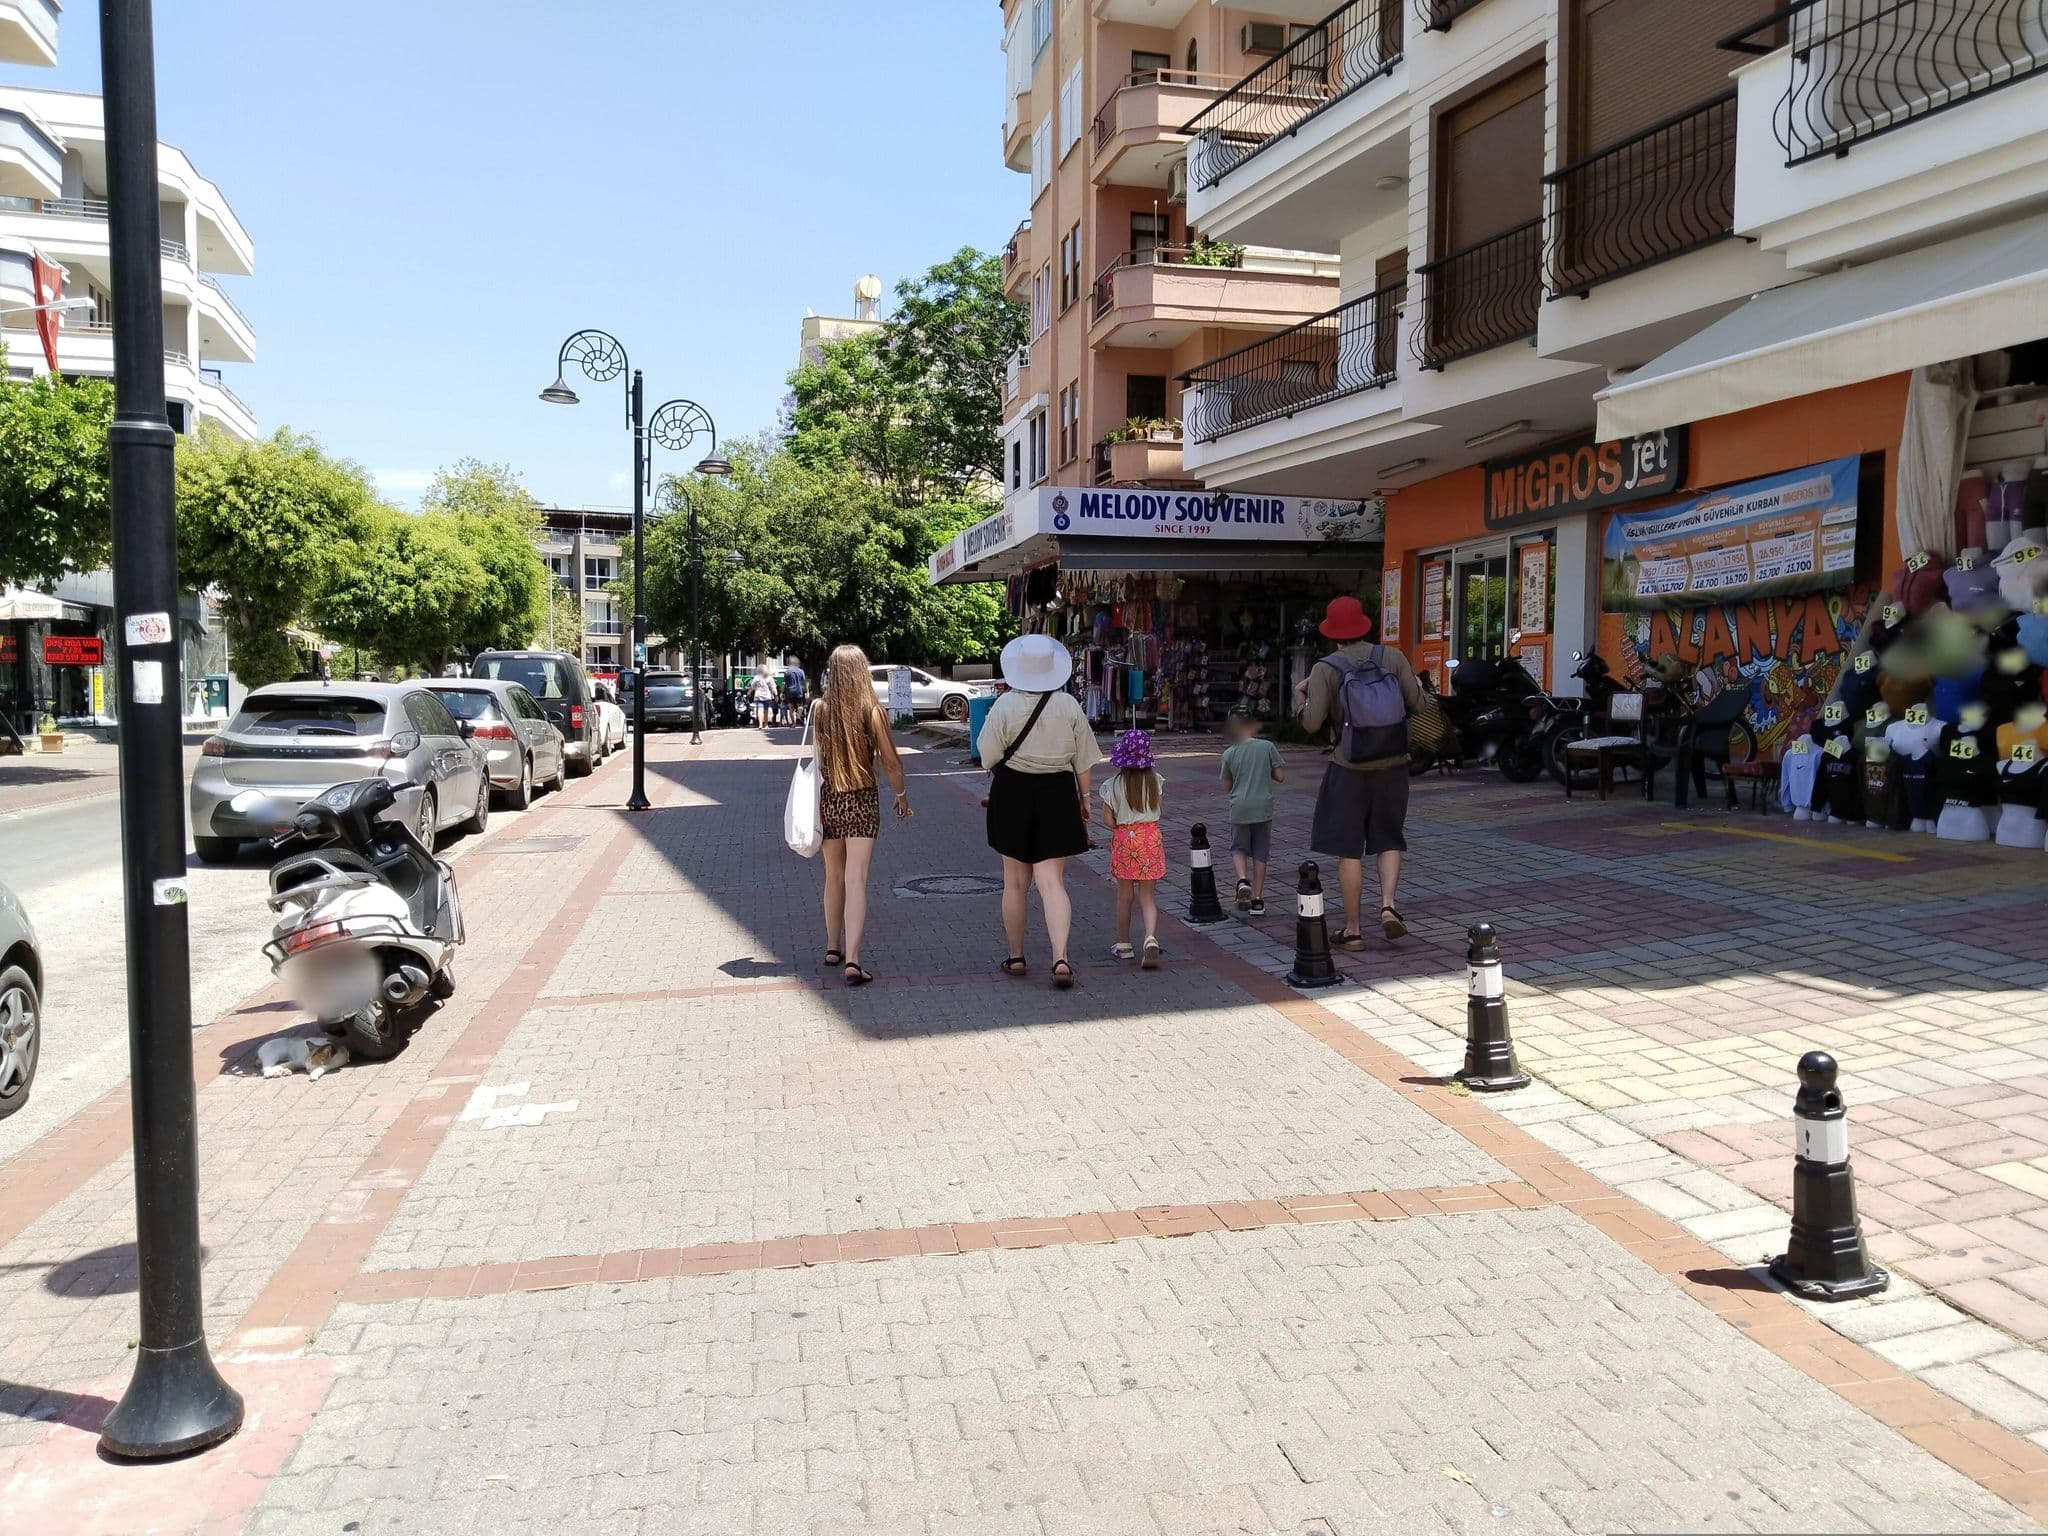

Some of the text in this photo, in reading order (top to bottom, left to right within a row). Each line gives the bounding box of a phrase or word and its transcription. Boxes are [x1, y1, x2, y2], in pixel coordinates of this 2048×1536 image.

[1080, 493, 1285, 524] MELODY SOUVENIR
[1703, 504, 1744, 521] GÜVENİLİR
[1746, 495, 1780, 512] KURBAN
[1155, 525, 1211, 534] SINCE 1993
[1649, 596, 1841, 668] ALANYA
